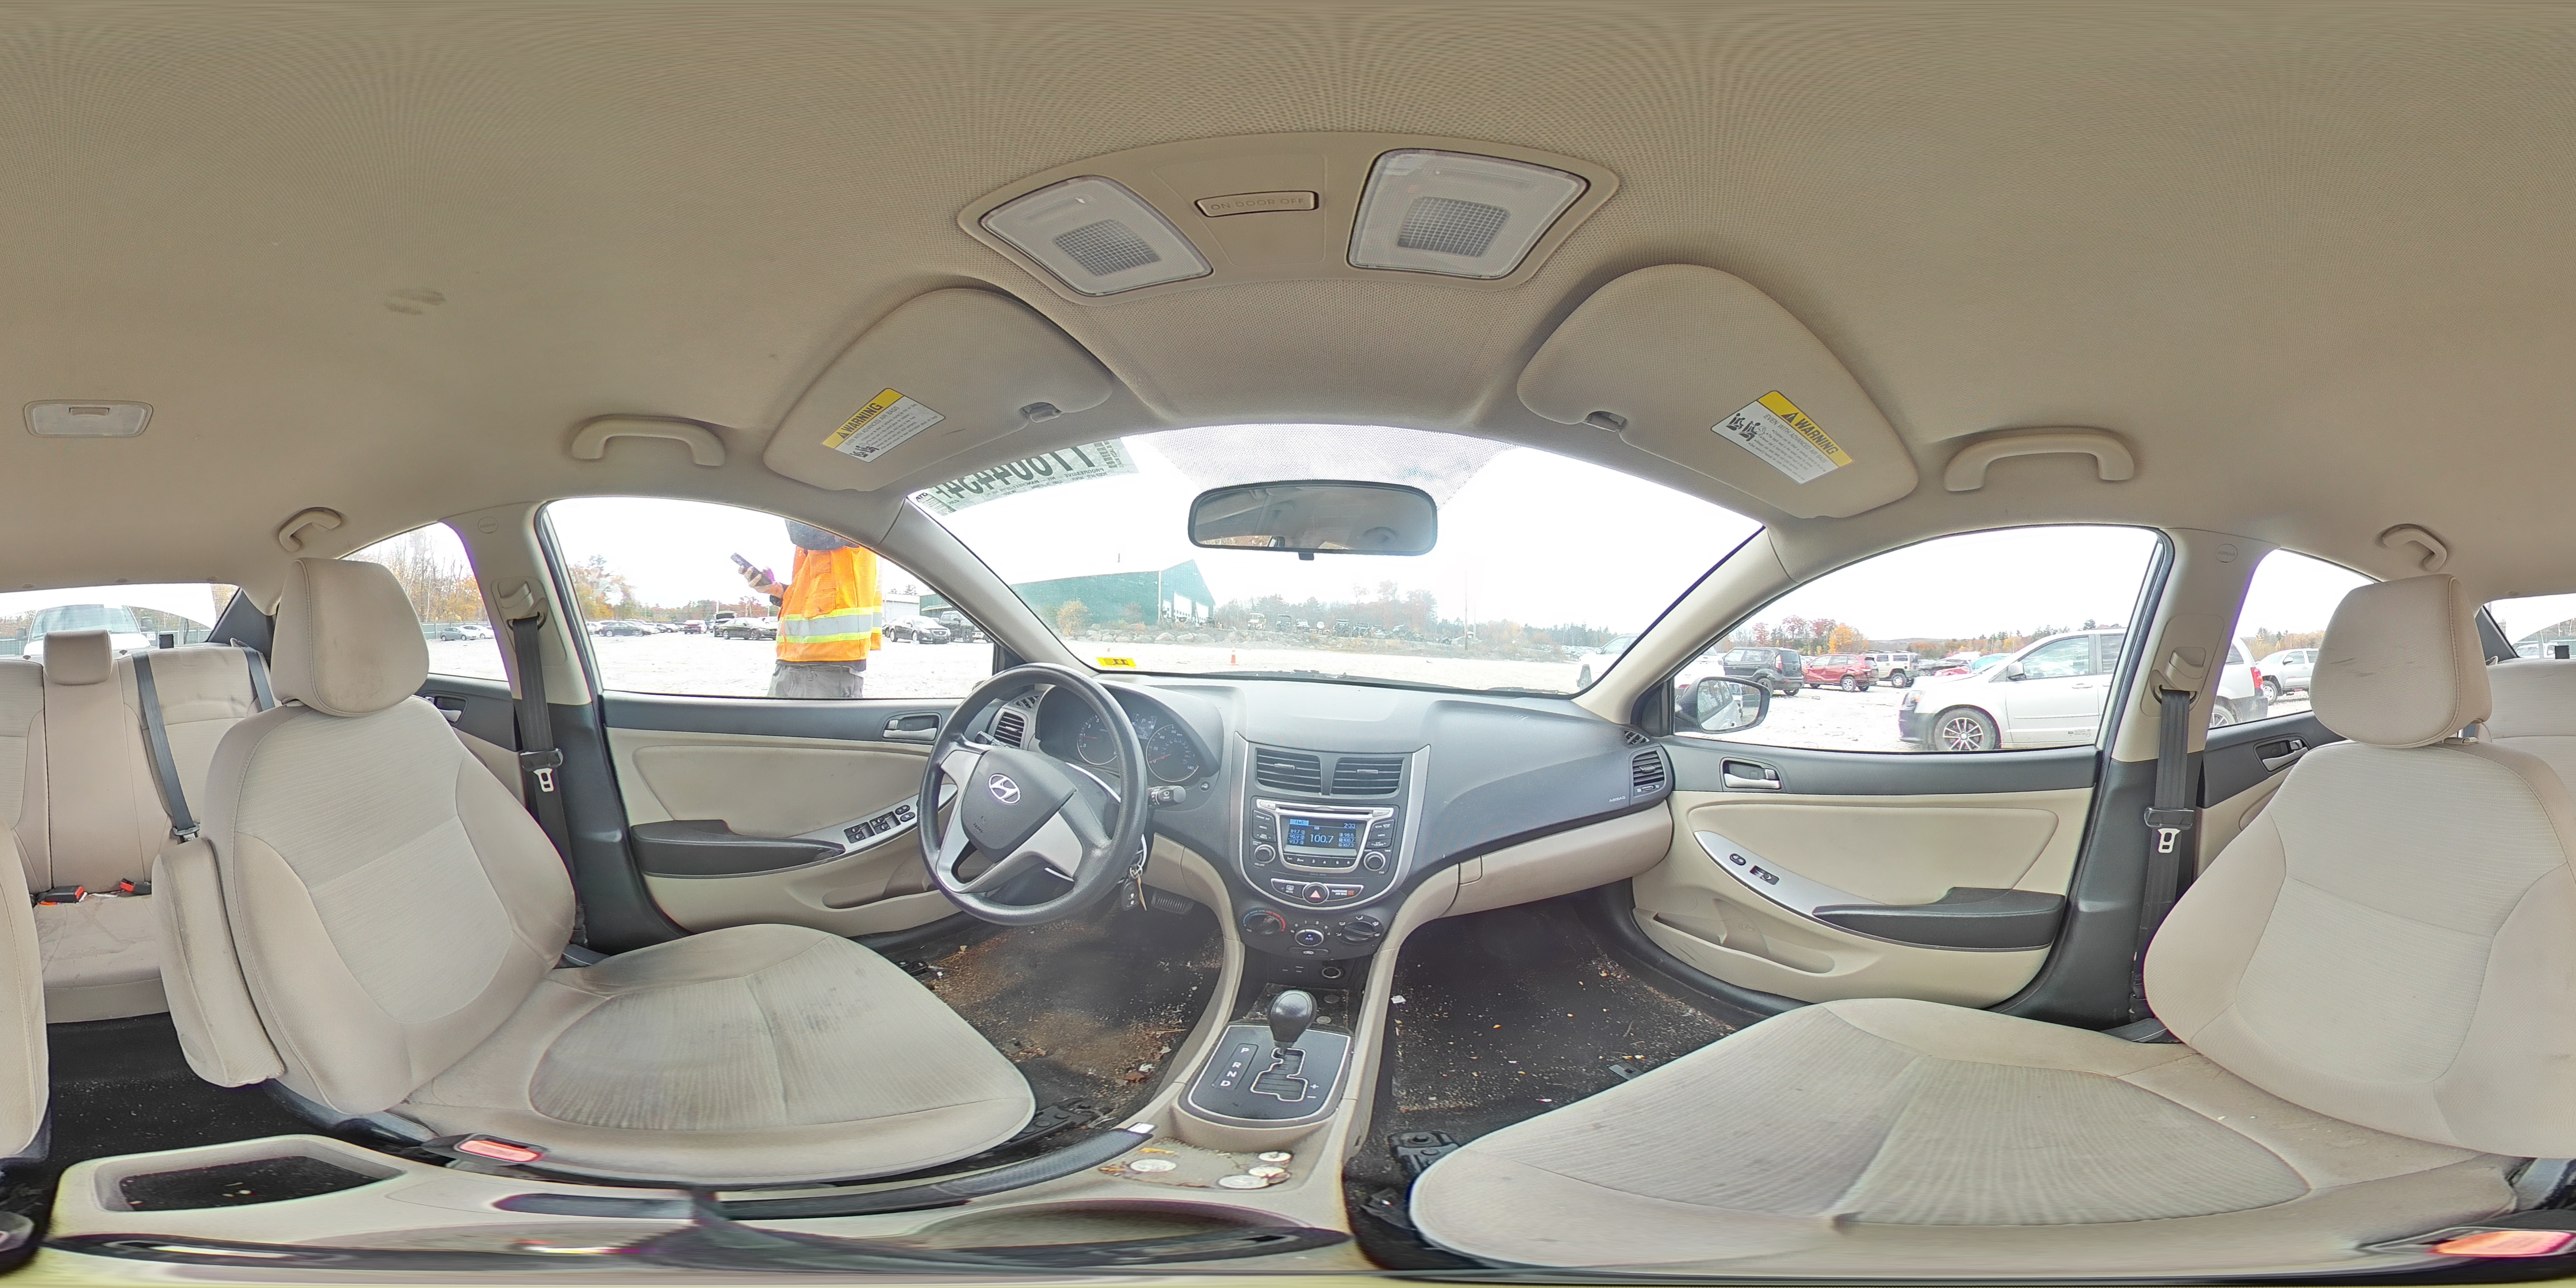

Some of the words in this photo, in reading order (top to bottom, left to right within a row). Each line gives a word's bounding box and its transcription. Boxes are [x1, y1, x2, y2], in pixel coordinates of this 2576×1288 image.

[841, 403, 884, 432] WARNING
[862, 419, 881, 433] ADVANCED
[886, 406, 900, 415] BAGS
[1763, 414, 1779, 426] EVEN
[1777, 424, 1790, 434] WITH
[1789, 433, 1811, 450] ADVANCED
[1816, 454, 1828, 463] BAGS
[1794, 418, 1839, 455] WARNING
[1310, 834, 1334, 843] 100.7
